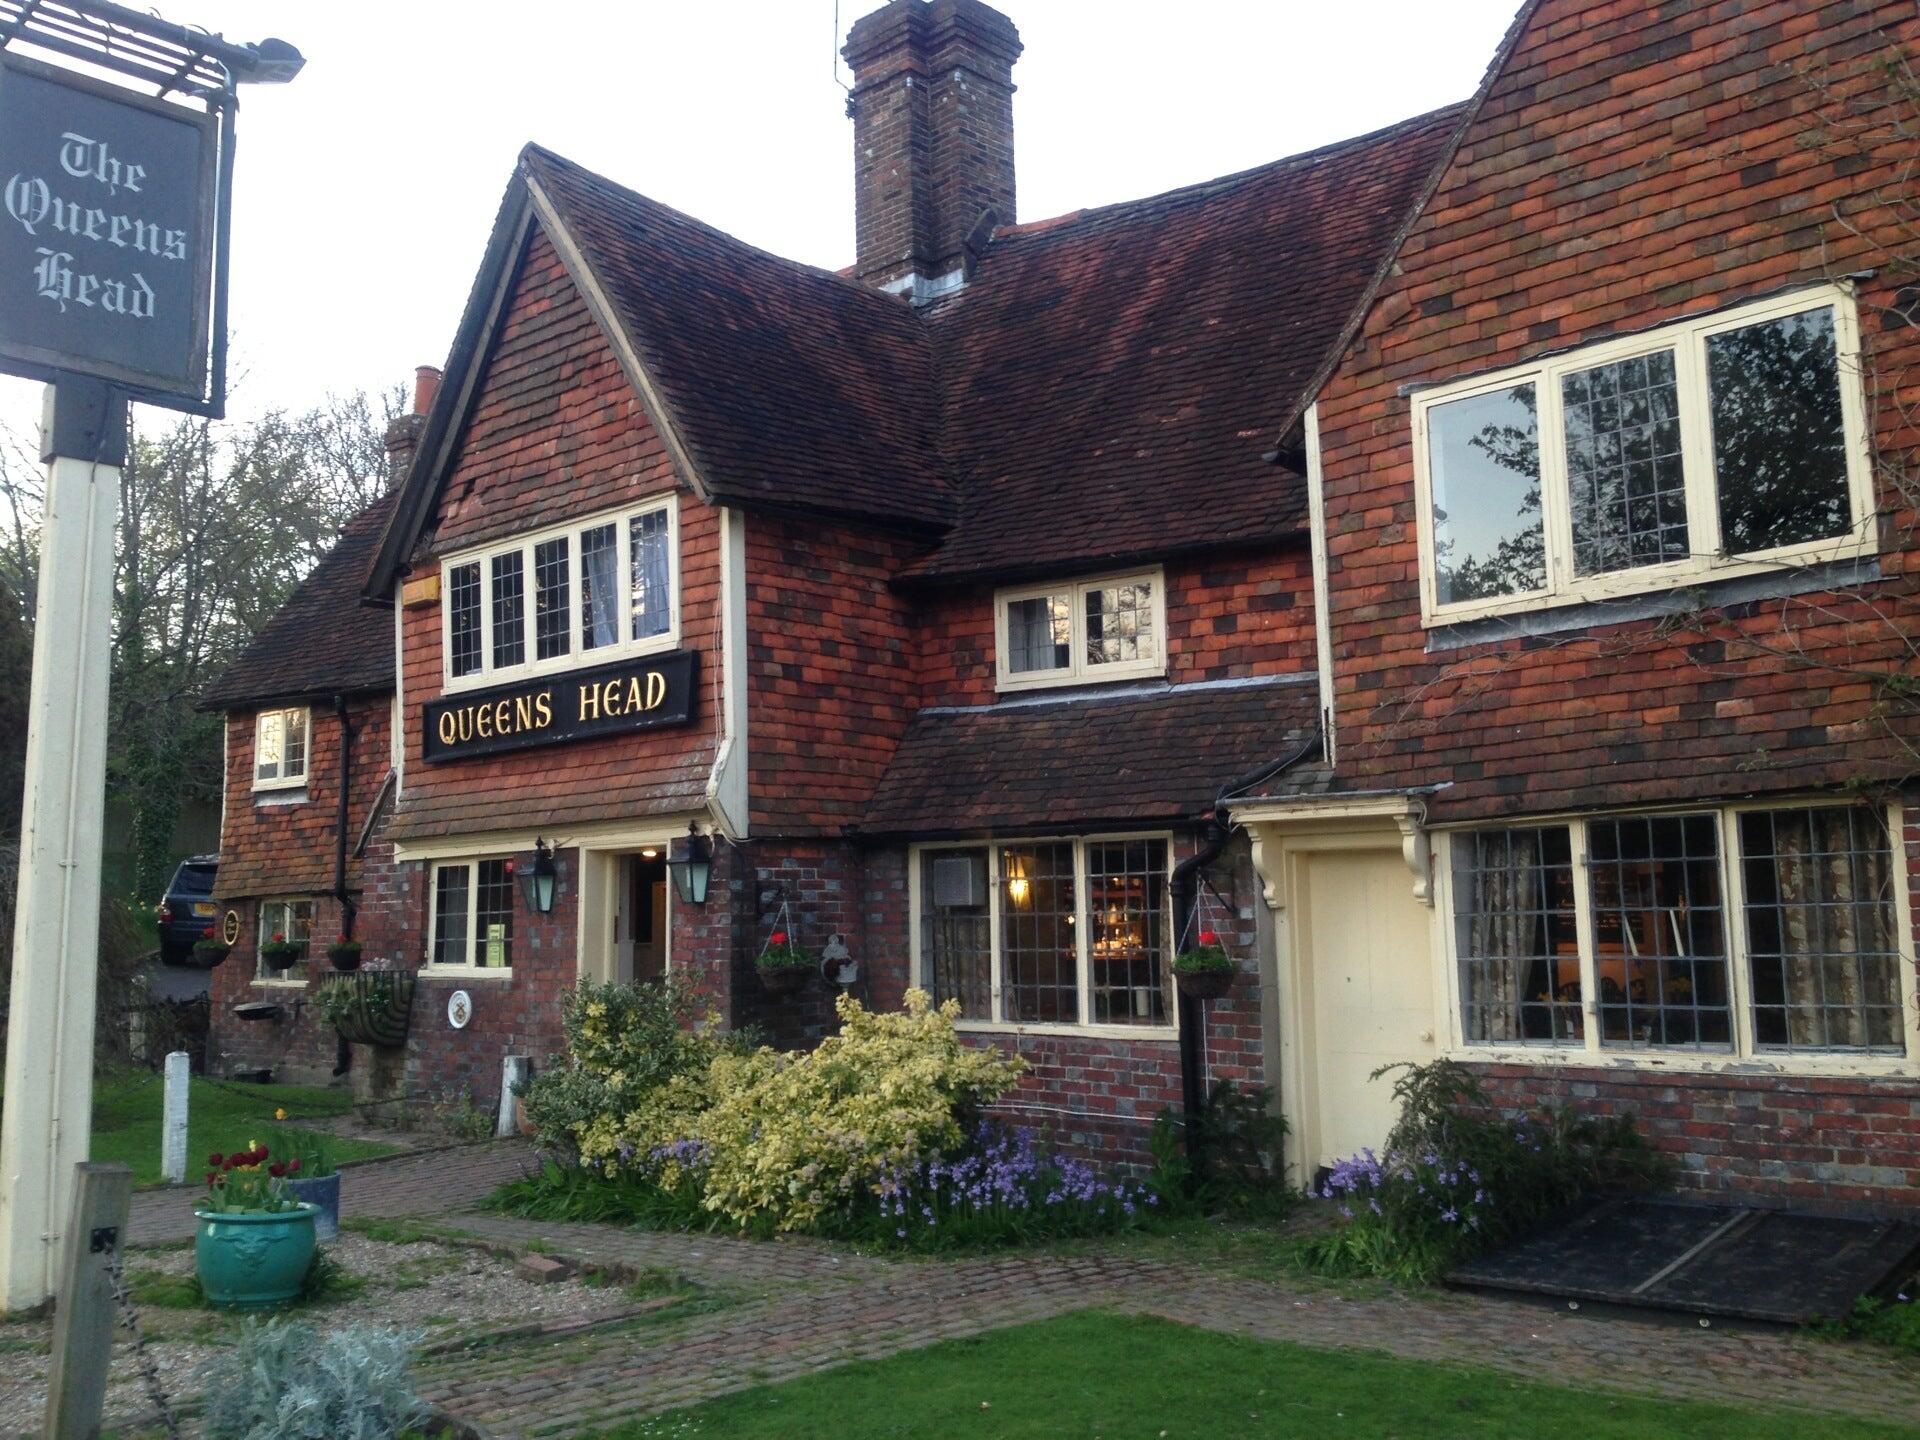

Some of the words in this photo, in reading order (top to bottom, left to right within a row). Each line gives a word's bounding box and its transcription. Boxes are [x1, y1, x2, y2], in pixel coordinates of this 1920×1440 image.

[60, 132, 146, 195] The
[5, 173, 186, 260] Queens
[34, 247, 155, 318] Head
[439, 692, 552, 745] QUEENS
[579, 672, 666, 721] HEAD
